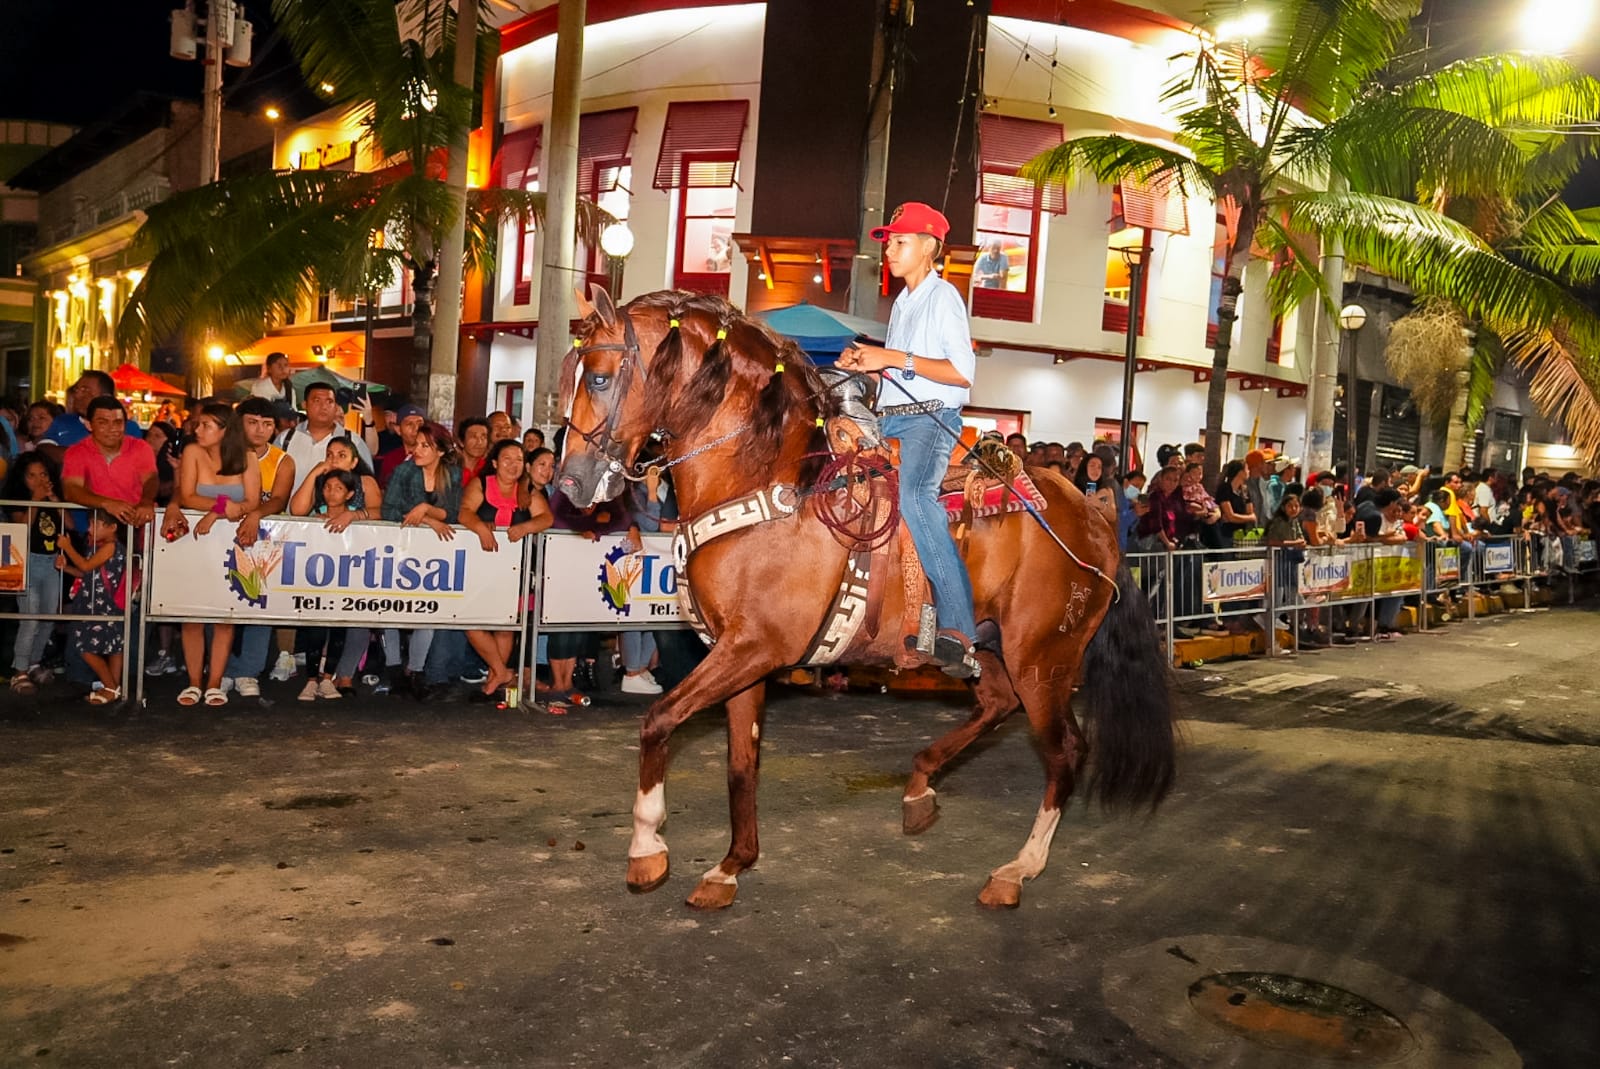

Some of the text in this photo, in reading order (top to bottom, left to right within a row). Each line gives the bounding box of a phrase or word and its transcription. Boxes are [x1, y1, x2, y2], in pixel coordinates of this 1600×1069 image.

[274, 541, 466, 591] Tortisal
[1312, 561, 1348, 580] Tortisal
[1220, 565, 1264, 588] Tortisal
[292, 596, 439, 614] Tel.: 26690129
[649, 603, 681, 616] Tel.:
